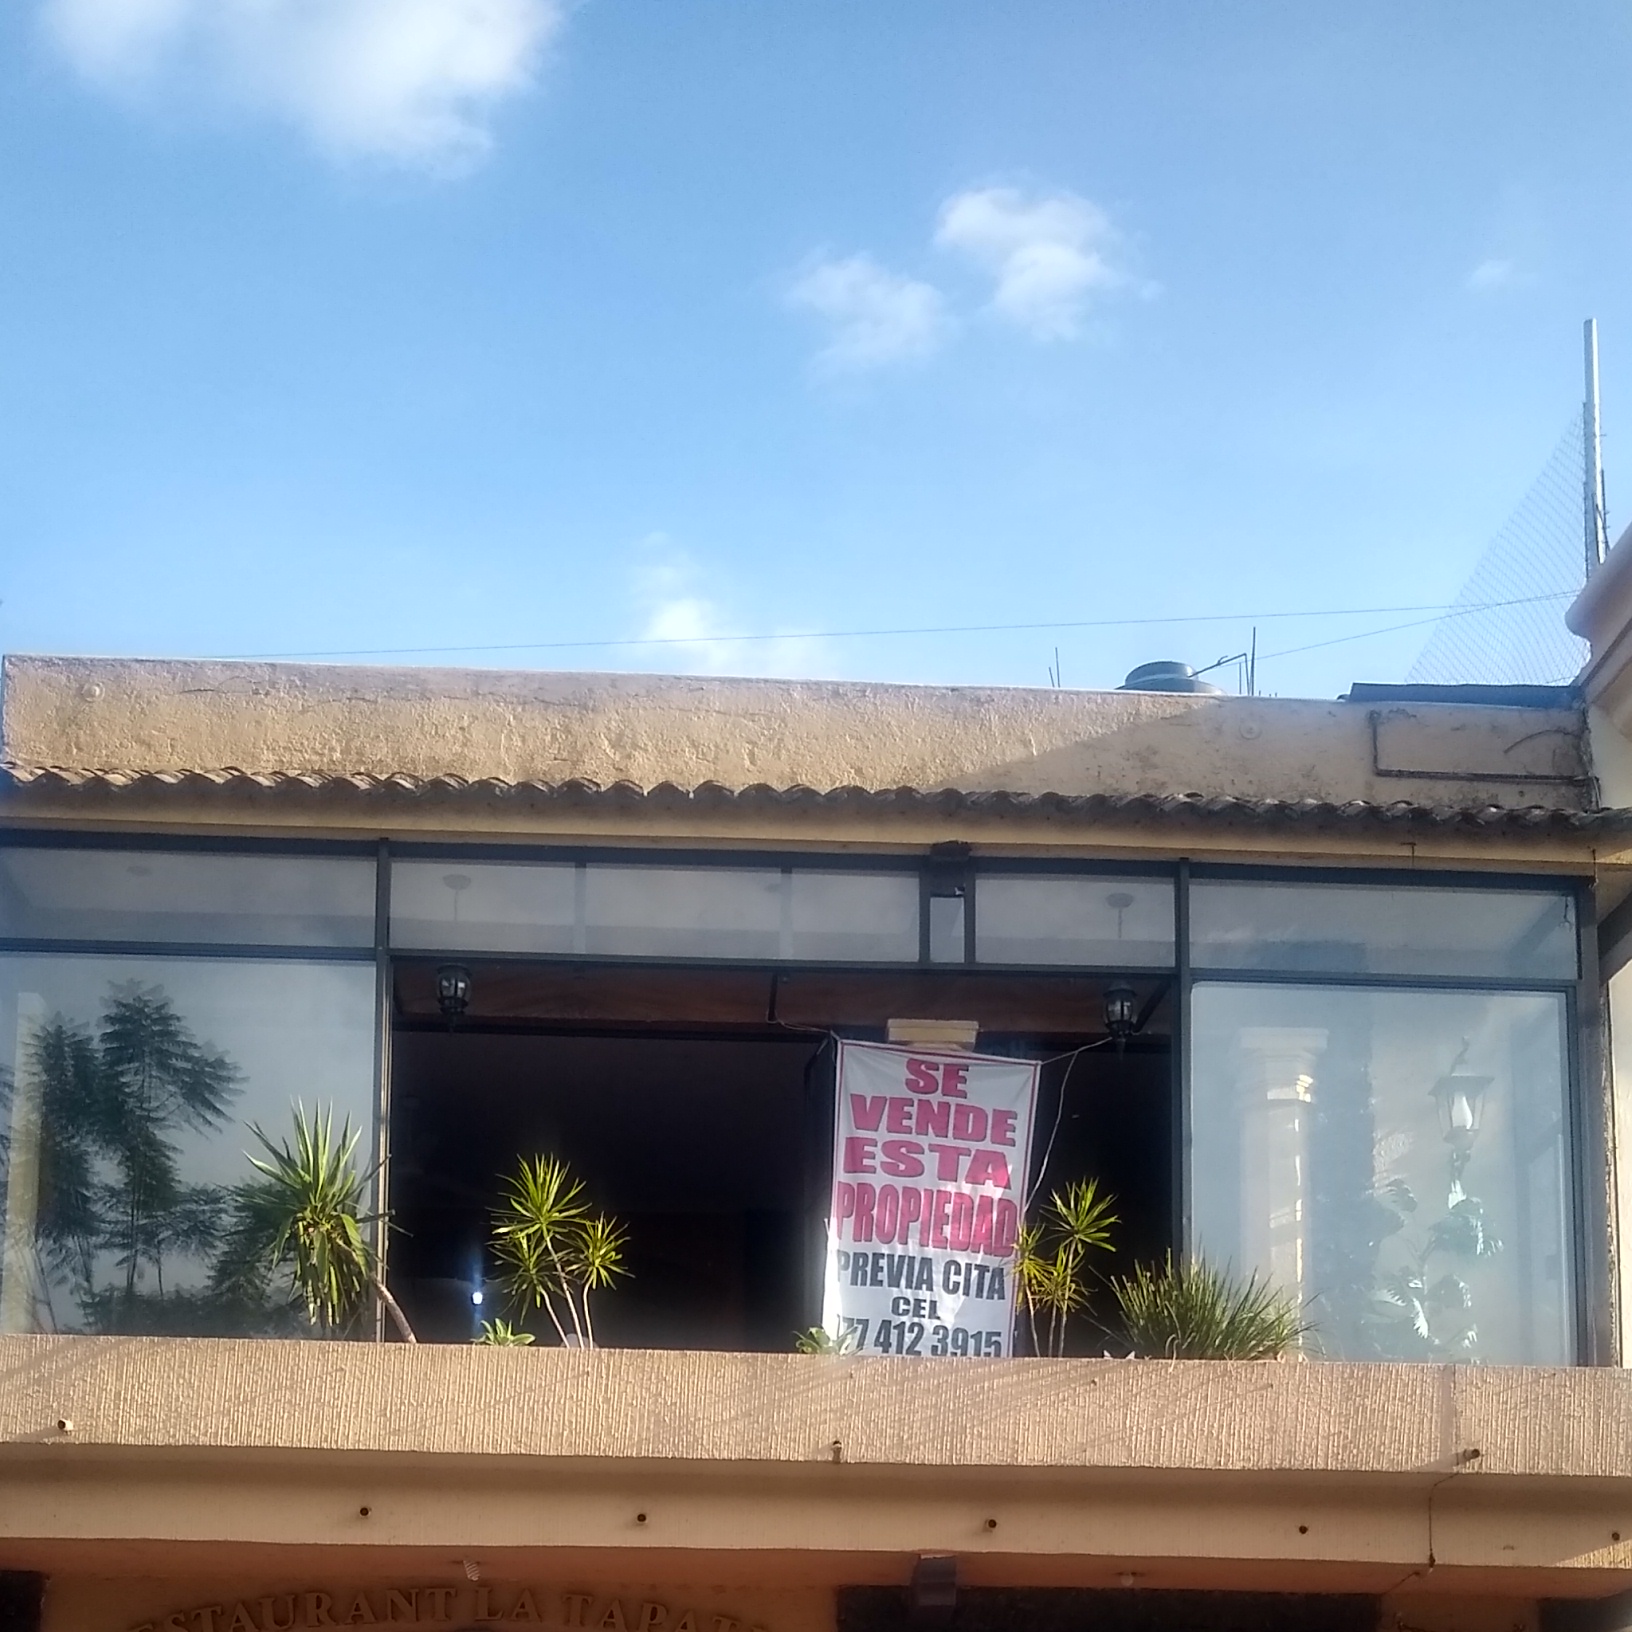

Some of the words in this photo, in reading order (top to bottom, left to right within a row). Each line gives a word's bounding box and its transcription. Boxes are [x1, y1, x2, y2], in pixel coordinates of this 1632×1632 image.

[905, 1058, 969, 1099] SE
[850, 1093, 1018, 1147] VENDE
[843, 1137, 1013, 1190] ESTA
[836, 1181, 1018, 1258] PROPIEDAD
[837, 1249, 934, 1292] PREVIA
[942, 1259, 1006, 1300] CITA
[891, 1296, 941, 1320] CEL
[873, 1319, 925, 1356] 412
[931, 1324, 1002, 1357] 3915
[474, 1586, 543, 1623] LA
